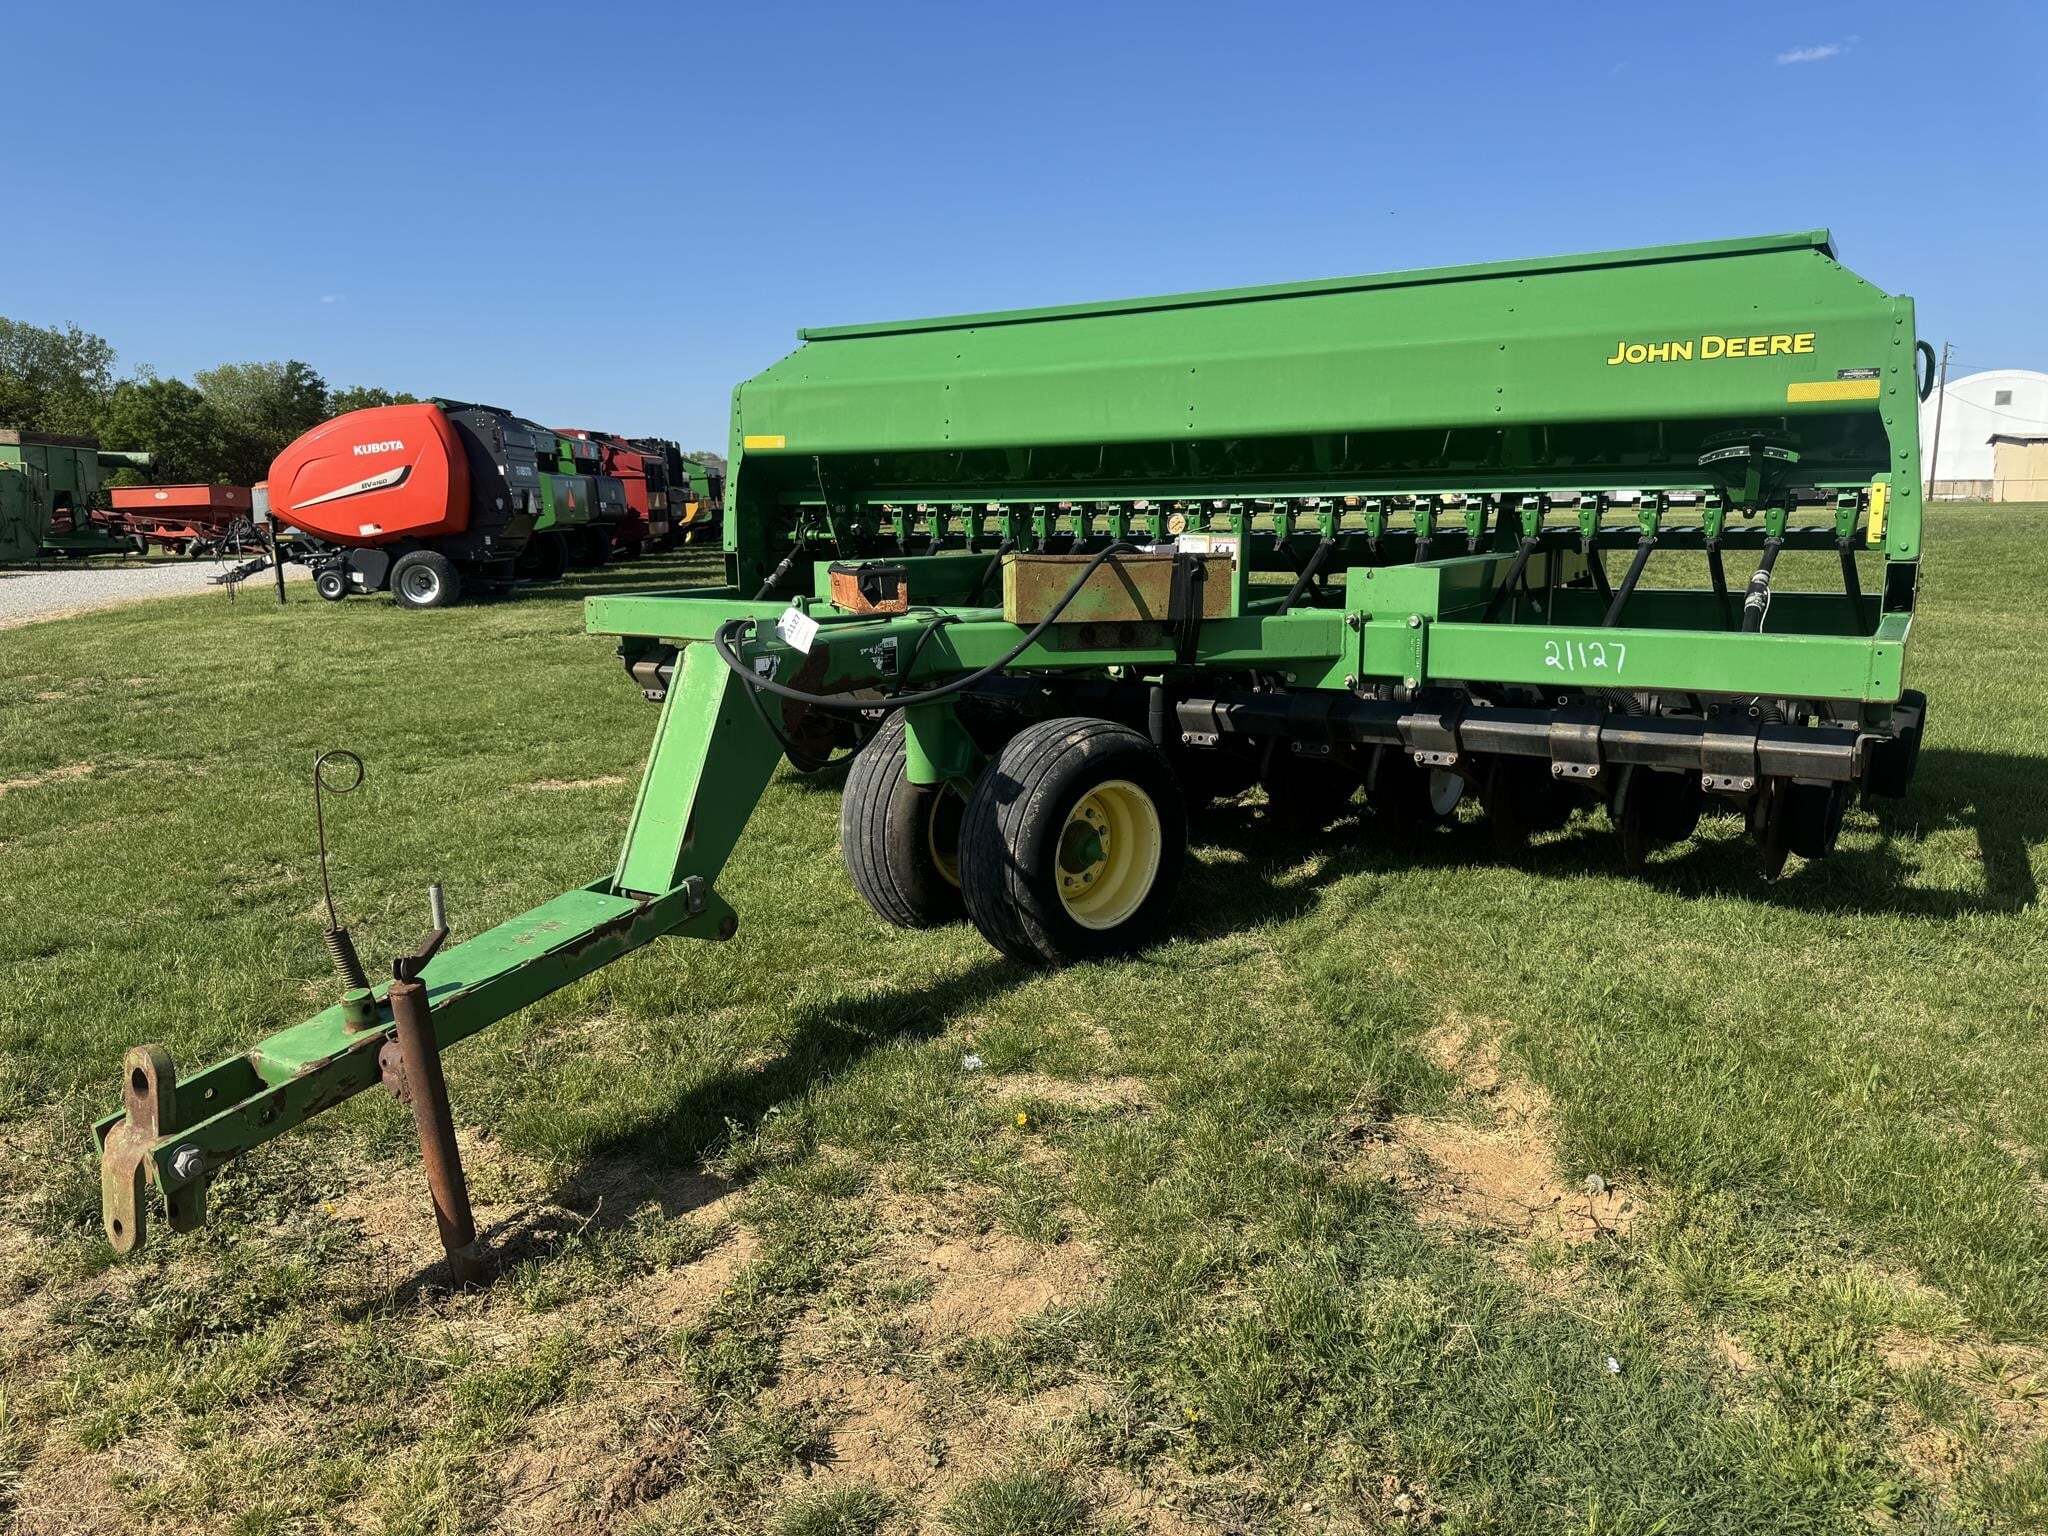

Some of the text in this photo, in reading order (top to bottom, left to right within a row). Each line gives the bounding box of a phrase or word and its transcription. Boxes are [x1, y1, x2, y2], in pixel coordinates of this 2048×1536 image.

[1607, 333, 1816, 366] JOHN DEERE
[352, 440, 405, 456] KUBOTA
[1544, 640, 1626, 674] 21127
